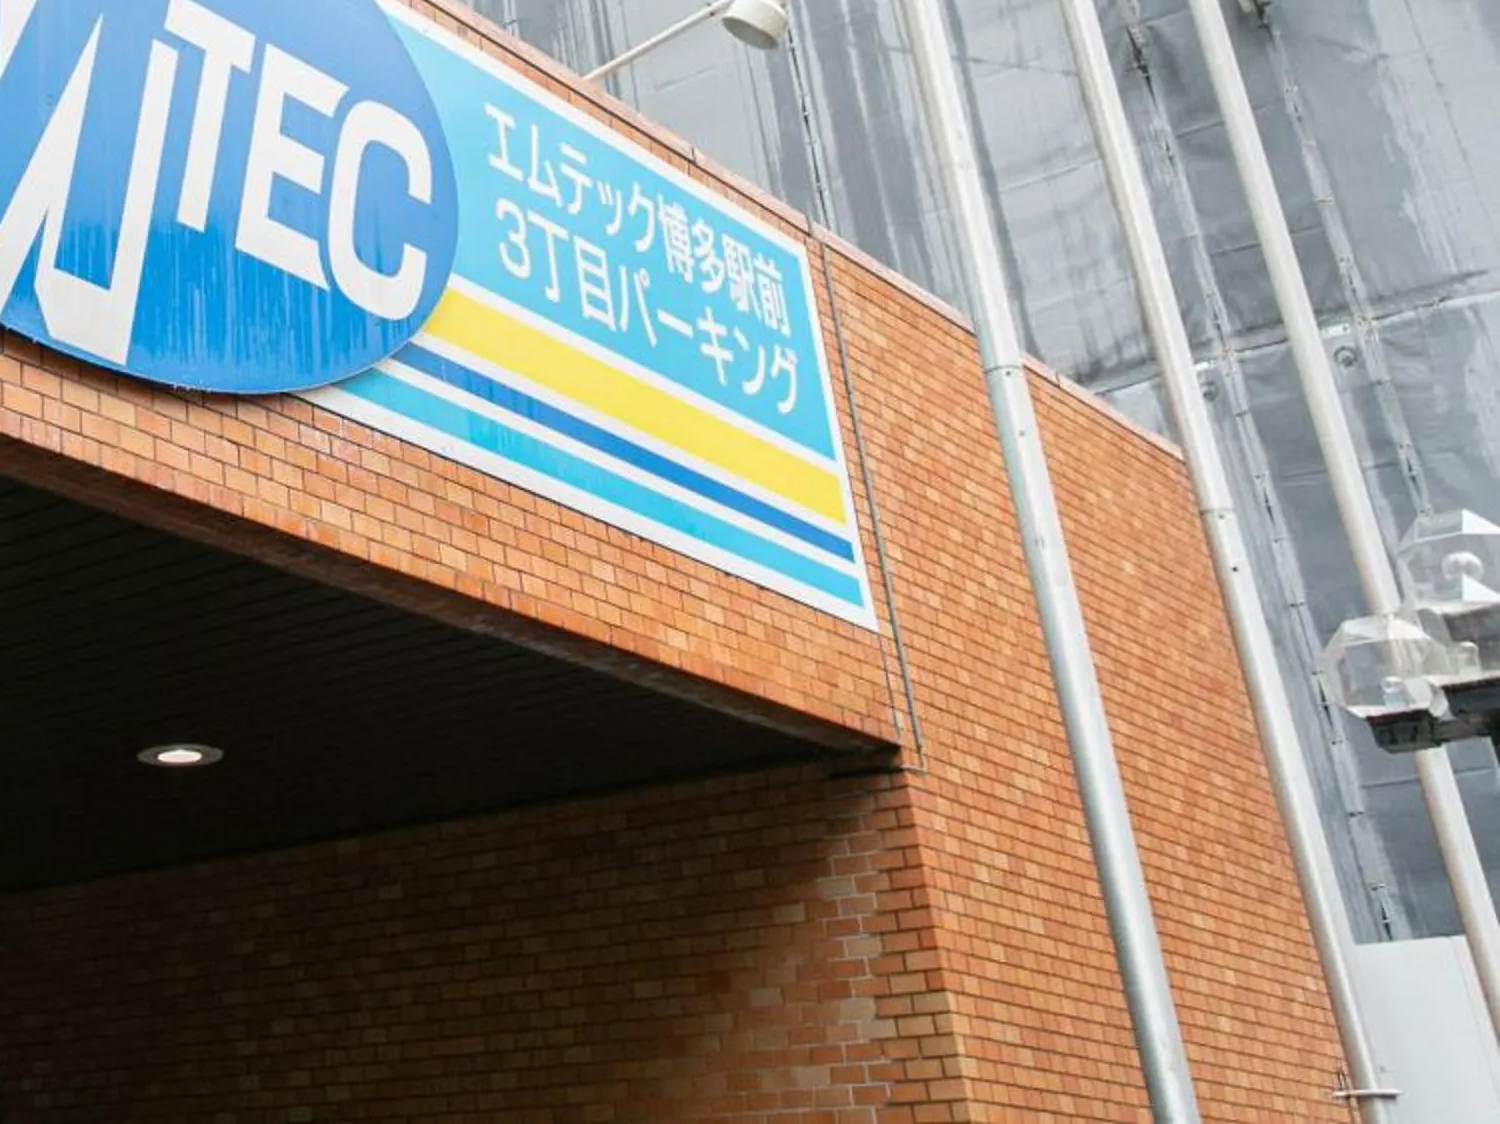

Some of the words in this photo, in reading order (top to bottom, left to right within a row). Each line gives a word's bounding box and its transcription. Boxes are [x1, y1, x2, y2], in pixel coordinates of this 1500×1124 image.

[485, 102, 791, 336] エムテック博多駅前
[496, 200, 798, 414] 3丁目パーキング
